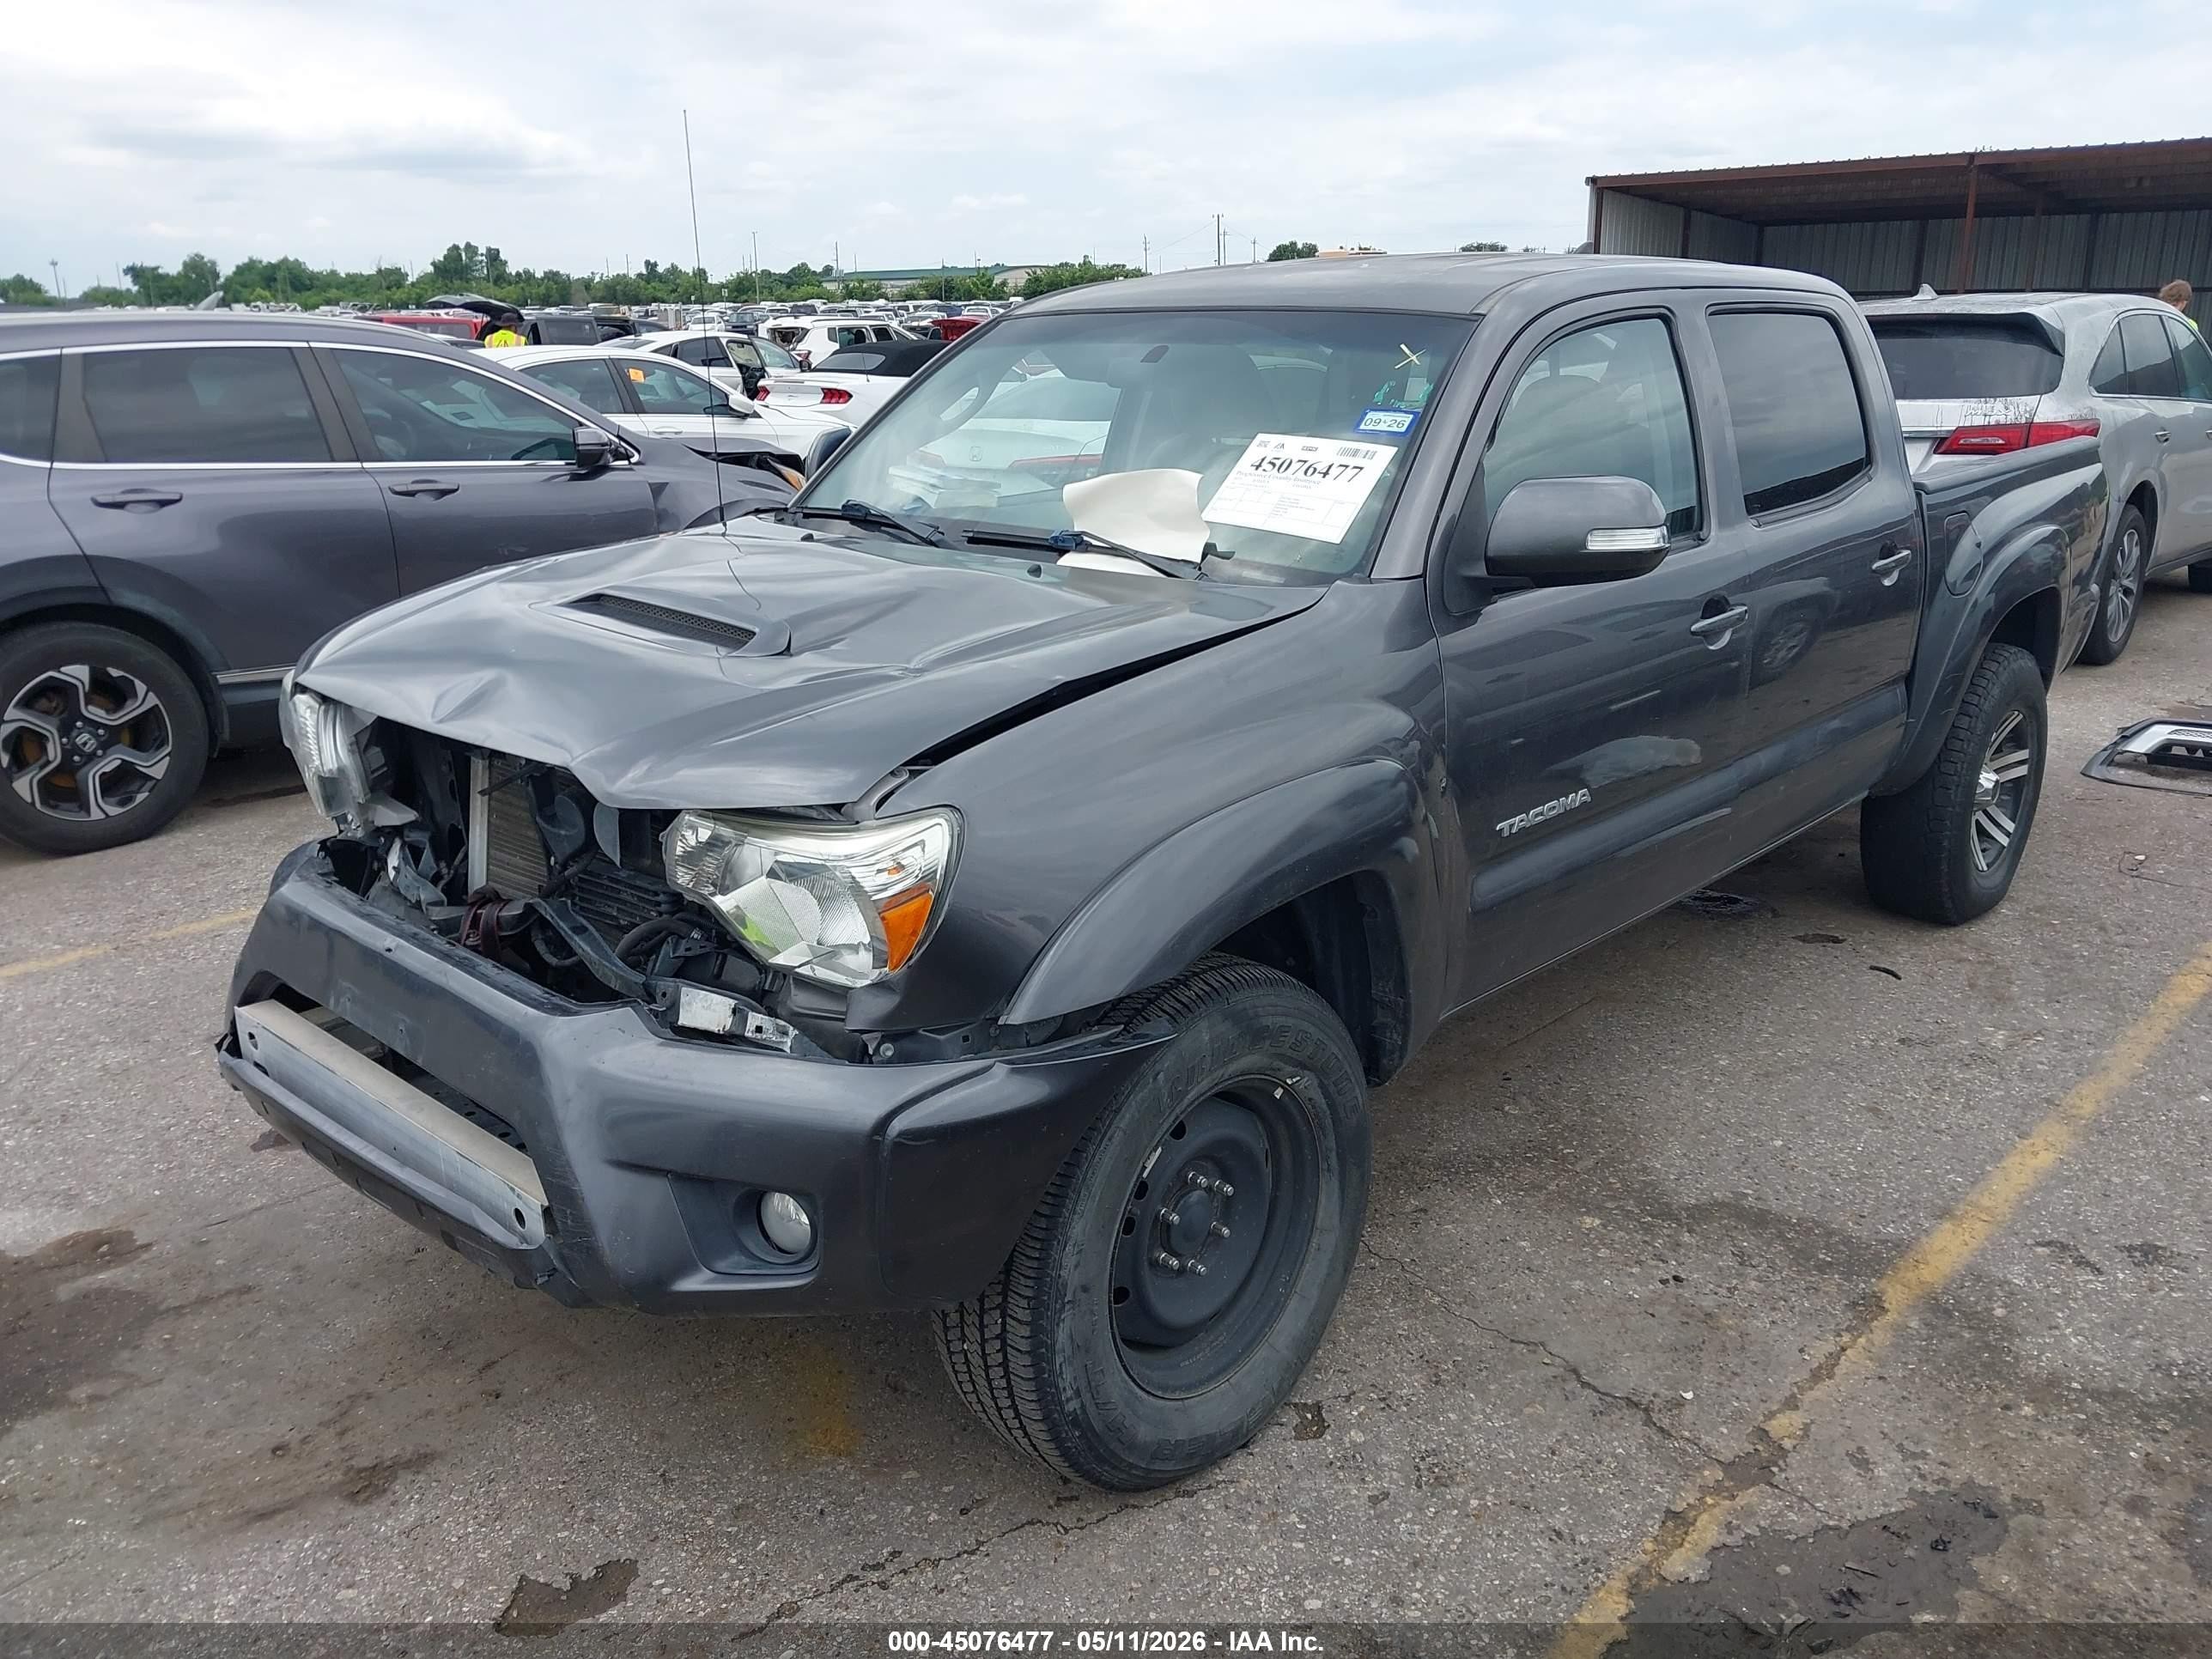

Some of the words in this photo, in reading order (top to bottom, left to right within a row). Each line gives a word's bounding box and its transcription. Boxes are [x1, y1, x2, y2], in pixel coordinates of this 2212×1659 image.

[1364, 417, 1382, 427] 09
[1387, 419, 1407, 428] 26
[1250, 455, 1364, 483] 45076477
[1496, 788, 1592, 837] TACOMA
